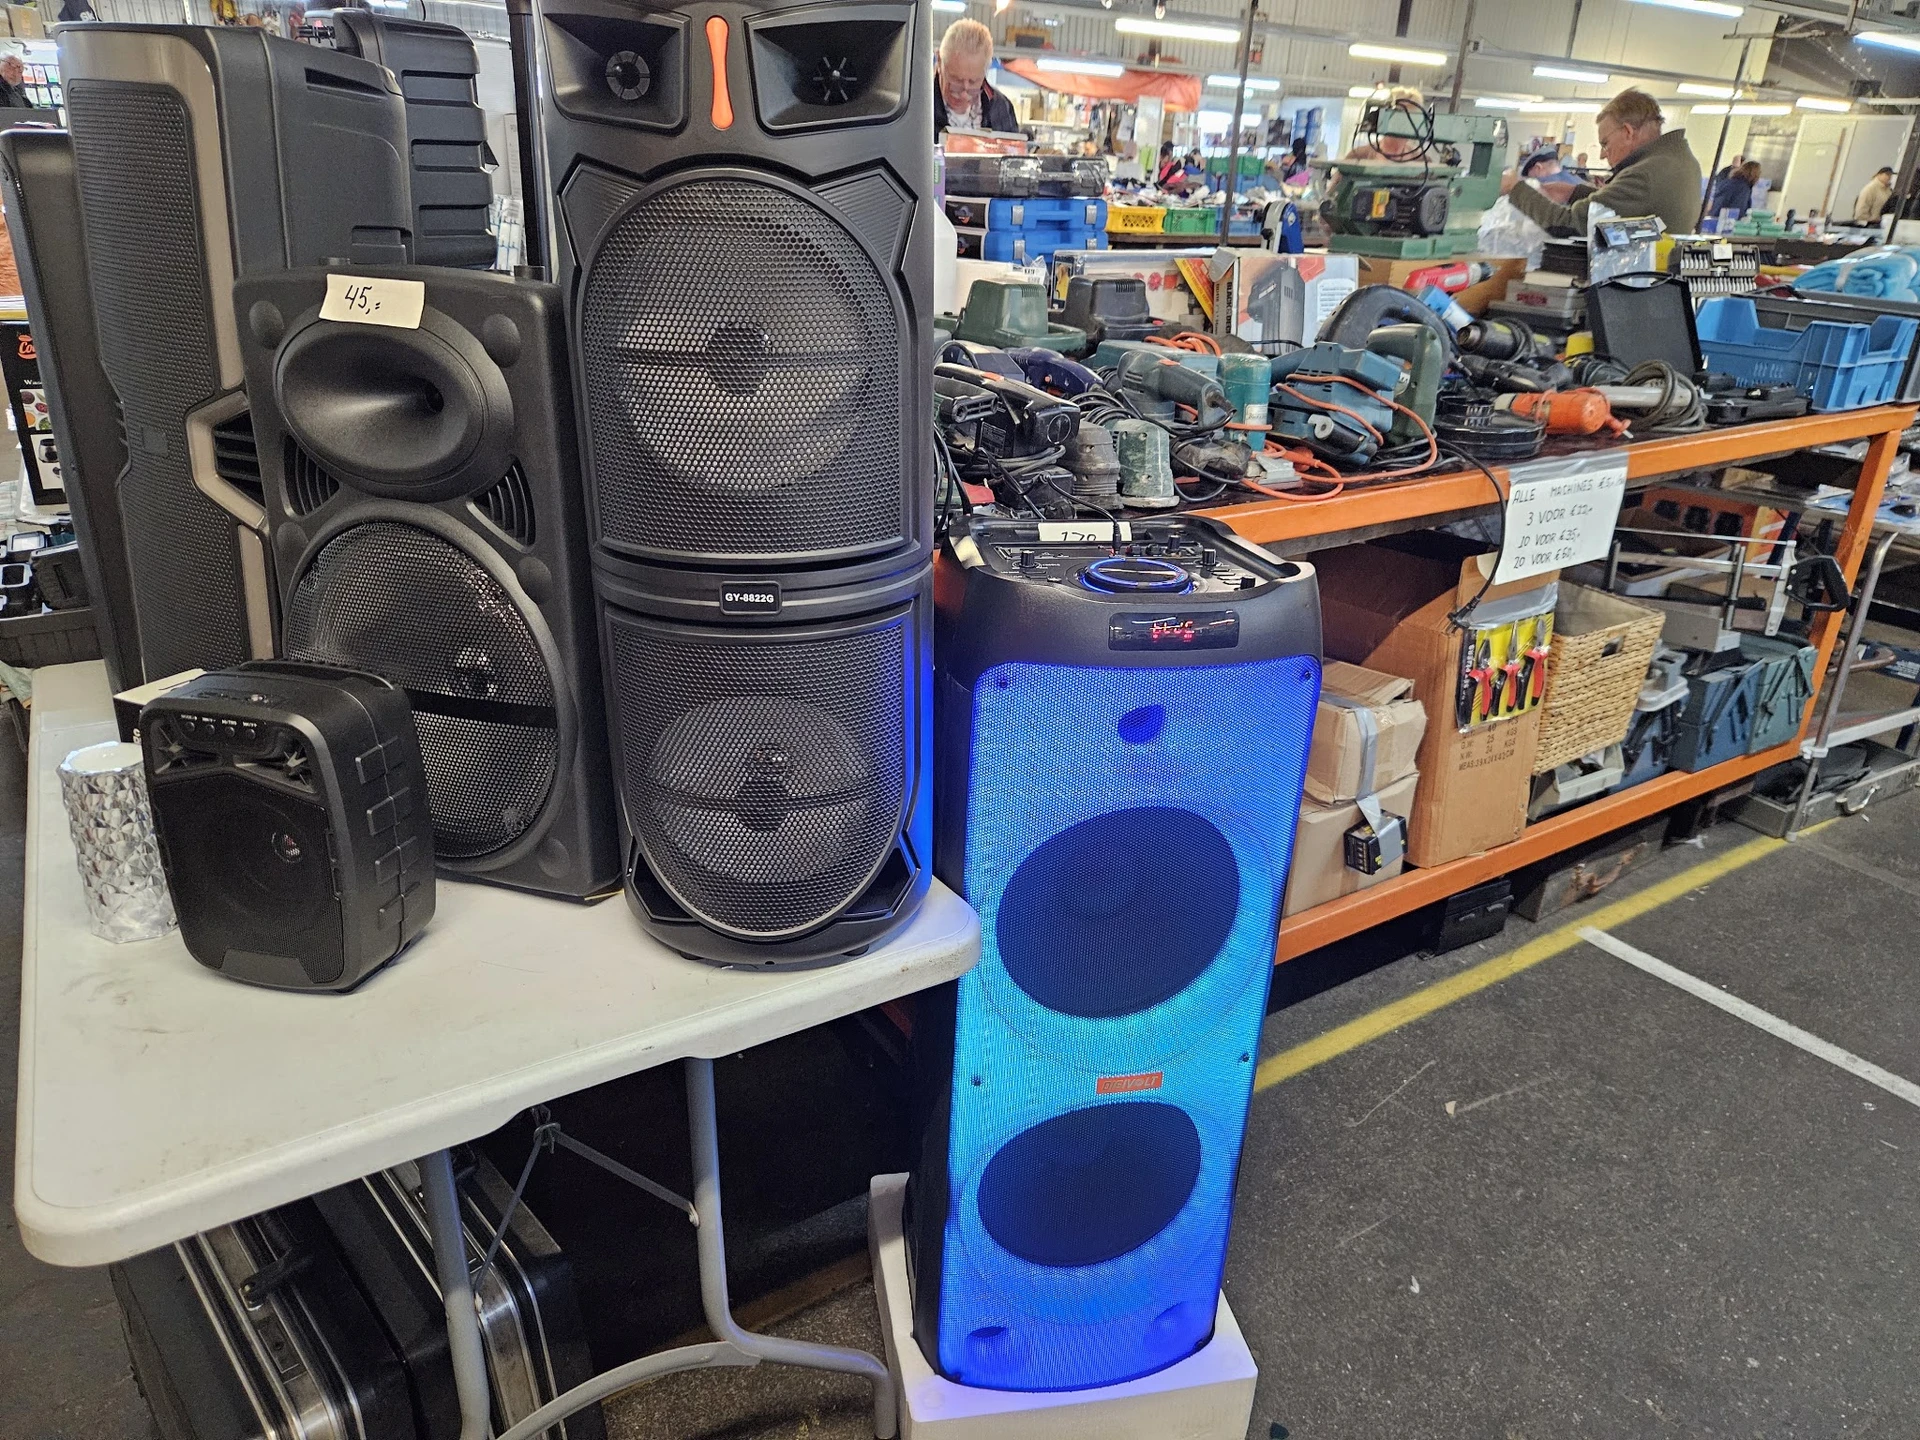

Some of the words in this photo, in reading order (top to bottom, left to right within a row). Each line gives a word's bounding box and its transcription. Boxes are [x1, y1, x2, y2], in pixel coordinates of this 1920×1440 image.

[1512, 488, 1536, 504] ALLE
[1550, 478, 1594, 497] MACHINES
[1526, 511, 1534, 526] 3
[1539, 507, 1566, 524] VOOR
[1518, 535, 1531, 549] 10
[1535, 532, 1557, 546] VOOR
[1513, 556, 1526, 569] 20
[1531, 551, 1552, 565] VOOR
[725, 592, 775, 604] GY-8822G
